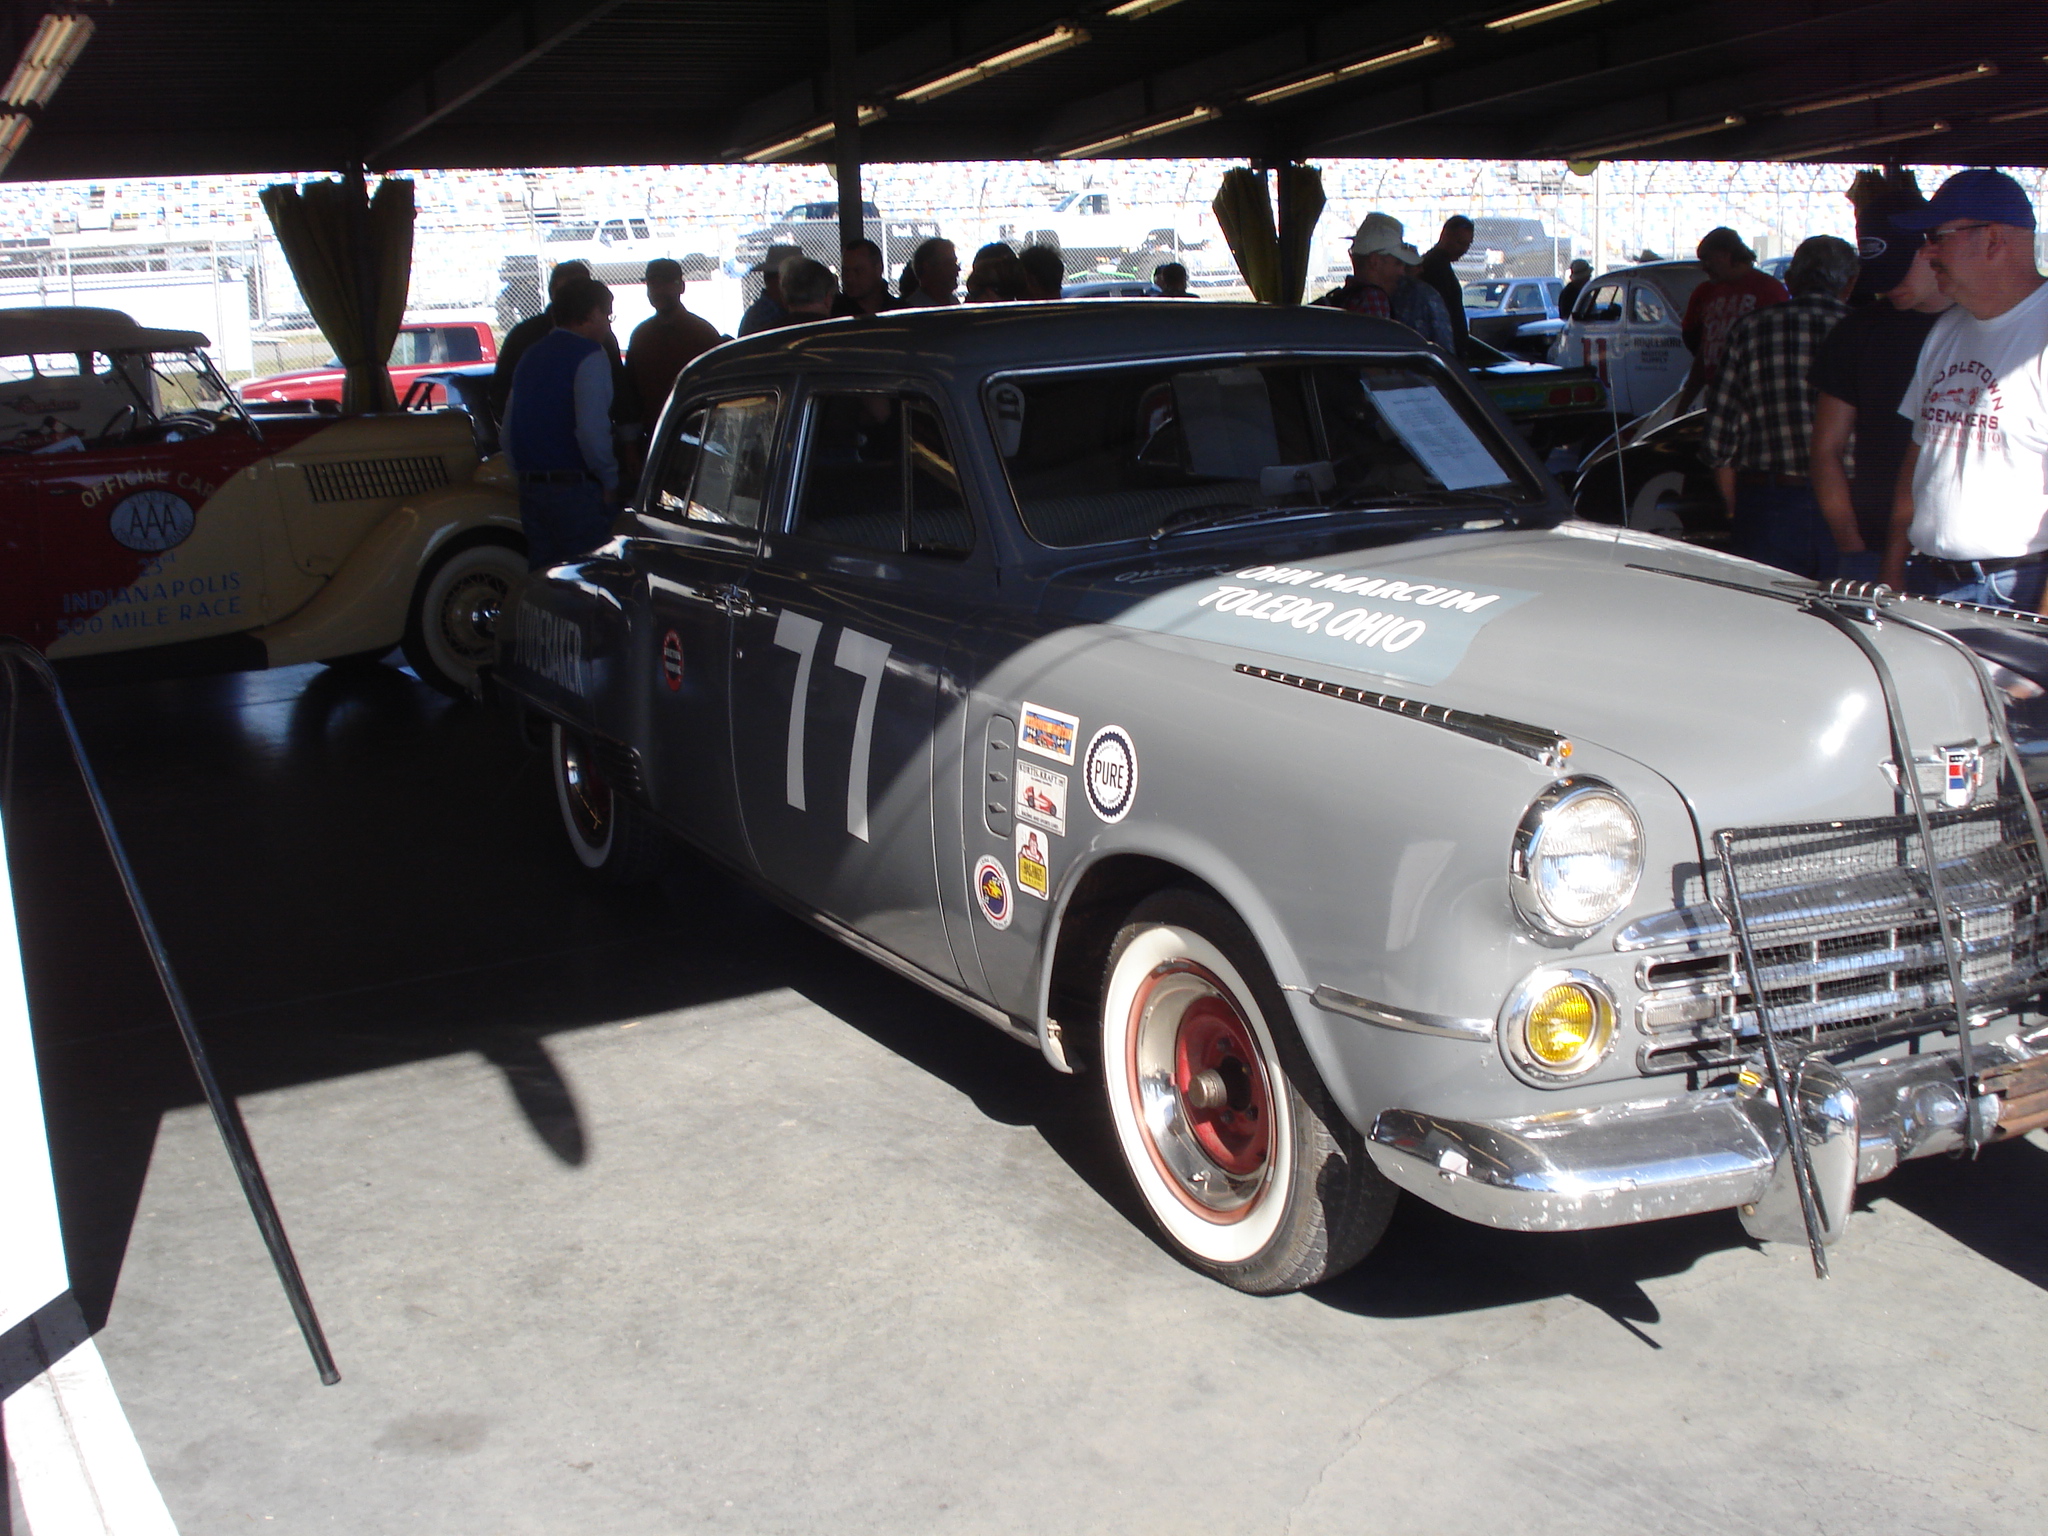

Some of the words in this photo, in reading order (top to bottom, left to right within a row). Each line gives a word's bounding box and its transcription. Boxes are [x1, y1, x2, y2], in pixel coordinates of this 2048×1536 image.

[81, 468, 169, 508] OFFICIAL
[177, 472, 216, 498] CAR
[130, 503, 177, 540] AAA
[63, 571, 241, 614] INDIANAPOLIS
[1309, 572, 1500, 614] MARCUM
[56, 616, 103, 638] 500
[112, 607, 170, 630] MILE
[180, 596, 242, 621] RACE
[1198, 585, 1325, 634] TOLEDO,
[1324, 608, 1427, 653] OHIO
[773, 608, 893, 845] 77
[1094, 759, 1124, 790] PURE
